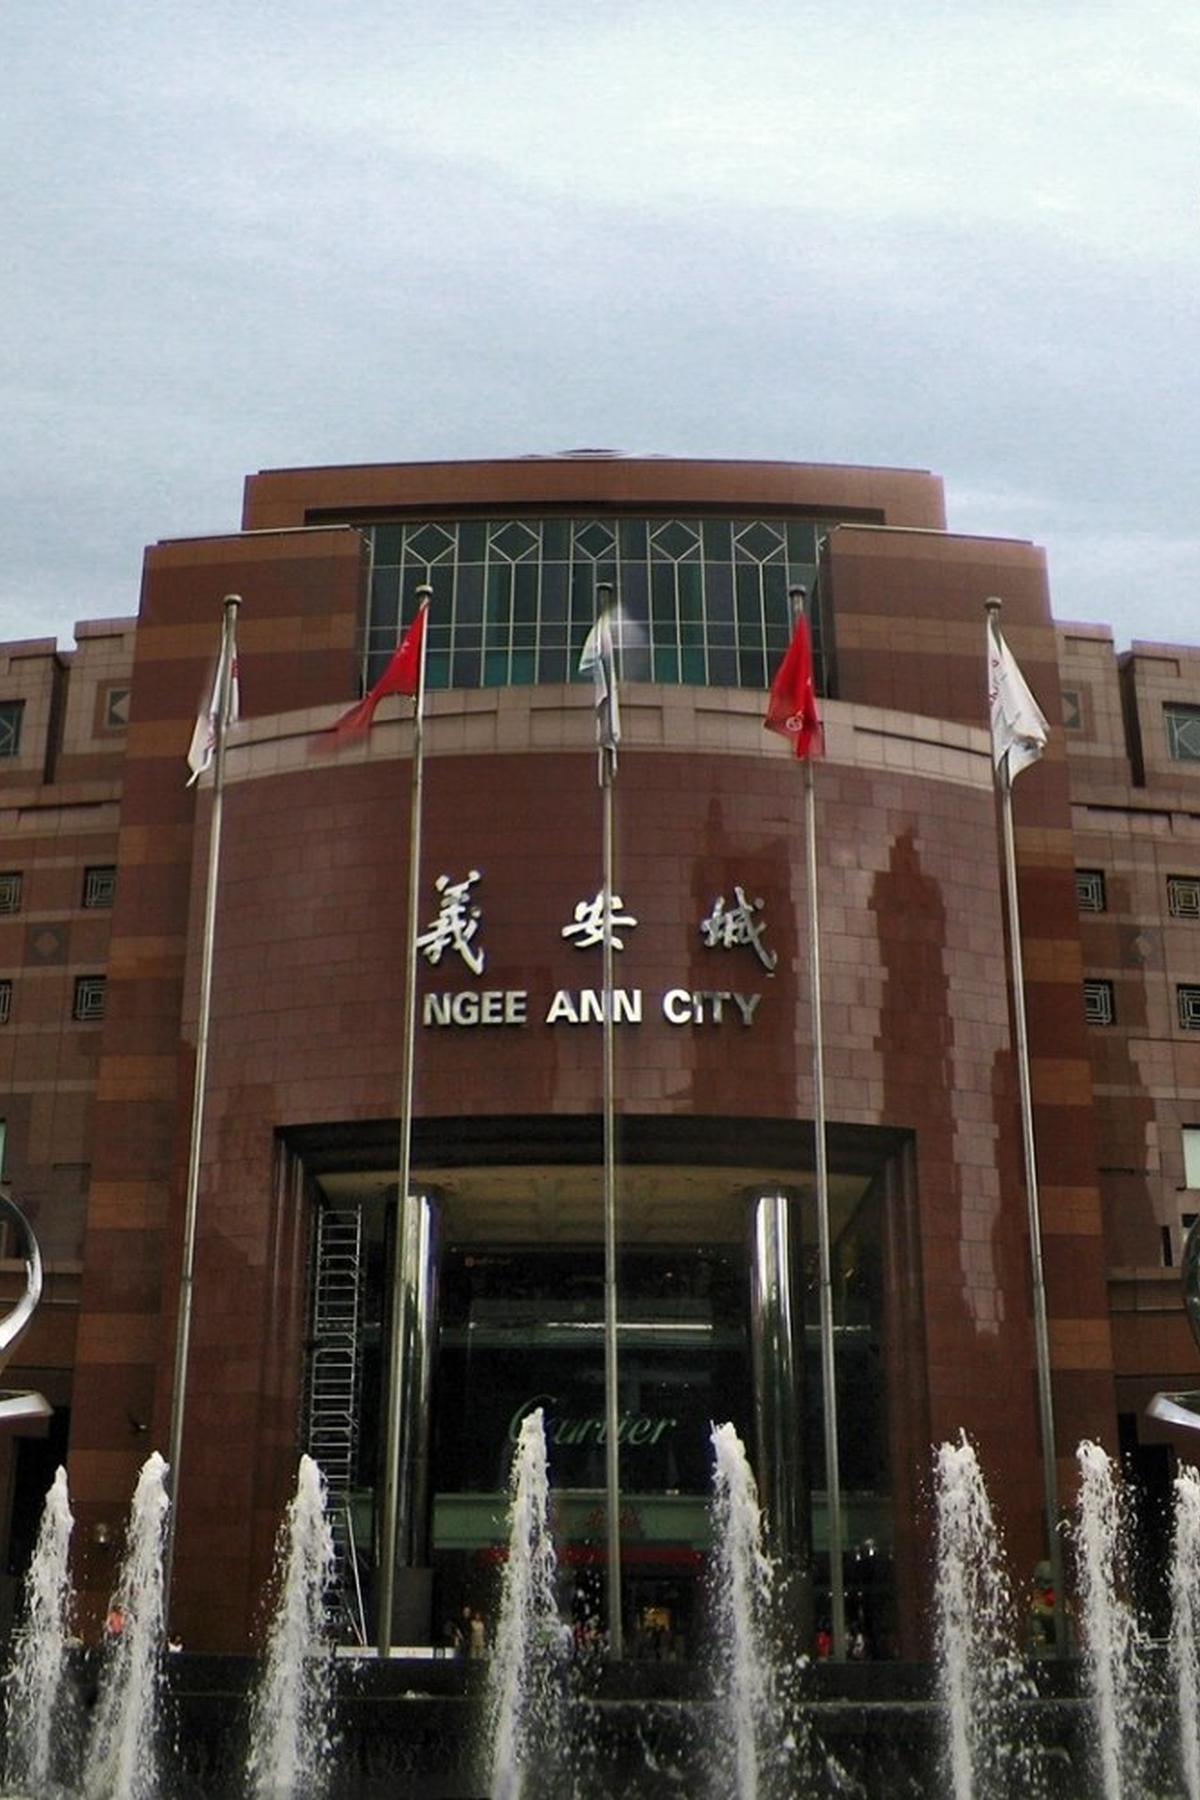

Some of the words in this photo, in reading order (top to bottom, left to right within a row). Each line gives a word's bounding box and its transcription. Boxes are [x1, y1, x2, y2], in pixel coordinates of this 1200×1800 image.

[423, 990, 527, 1026] NGEE
[545, 989, 642, 1024] ANN
[662, 988, 762, 1026] CITY
